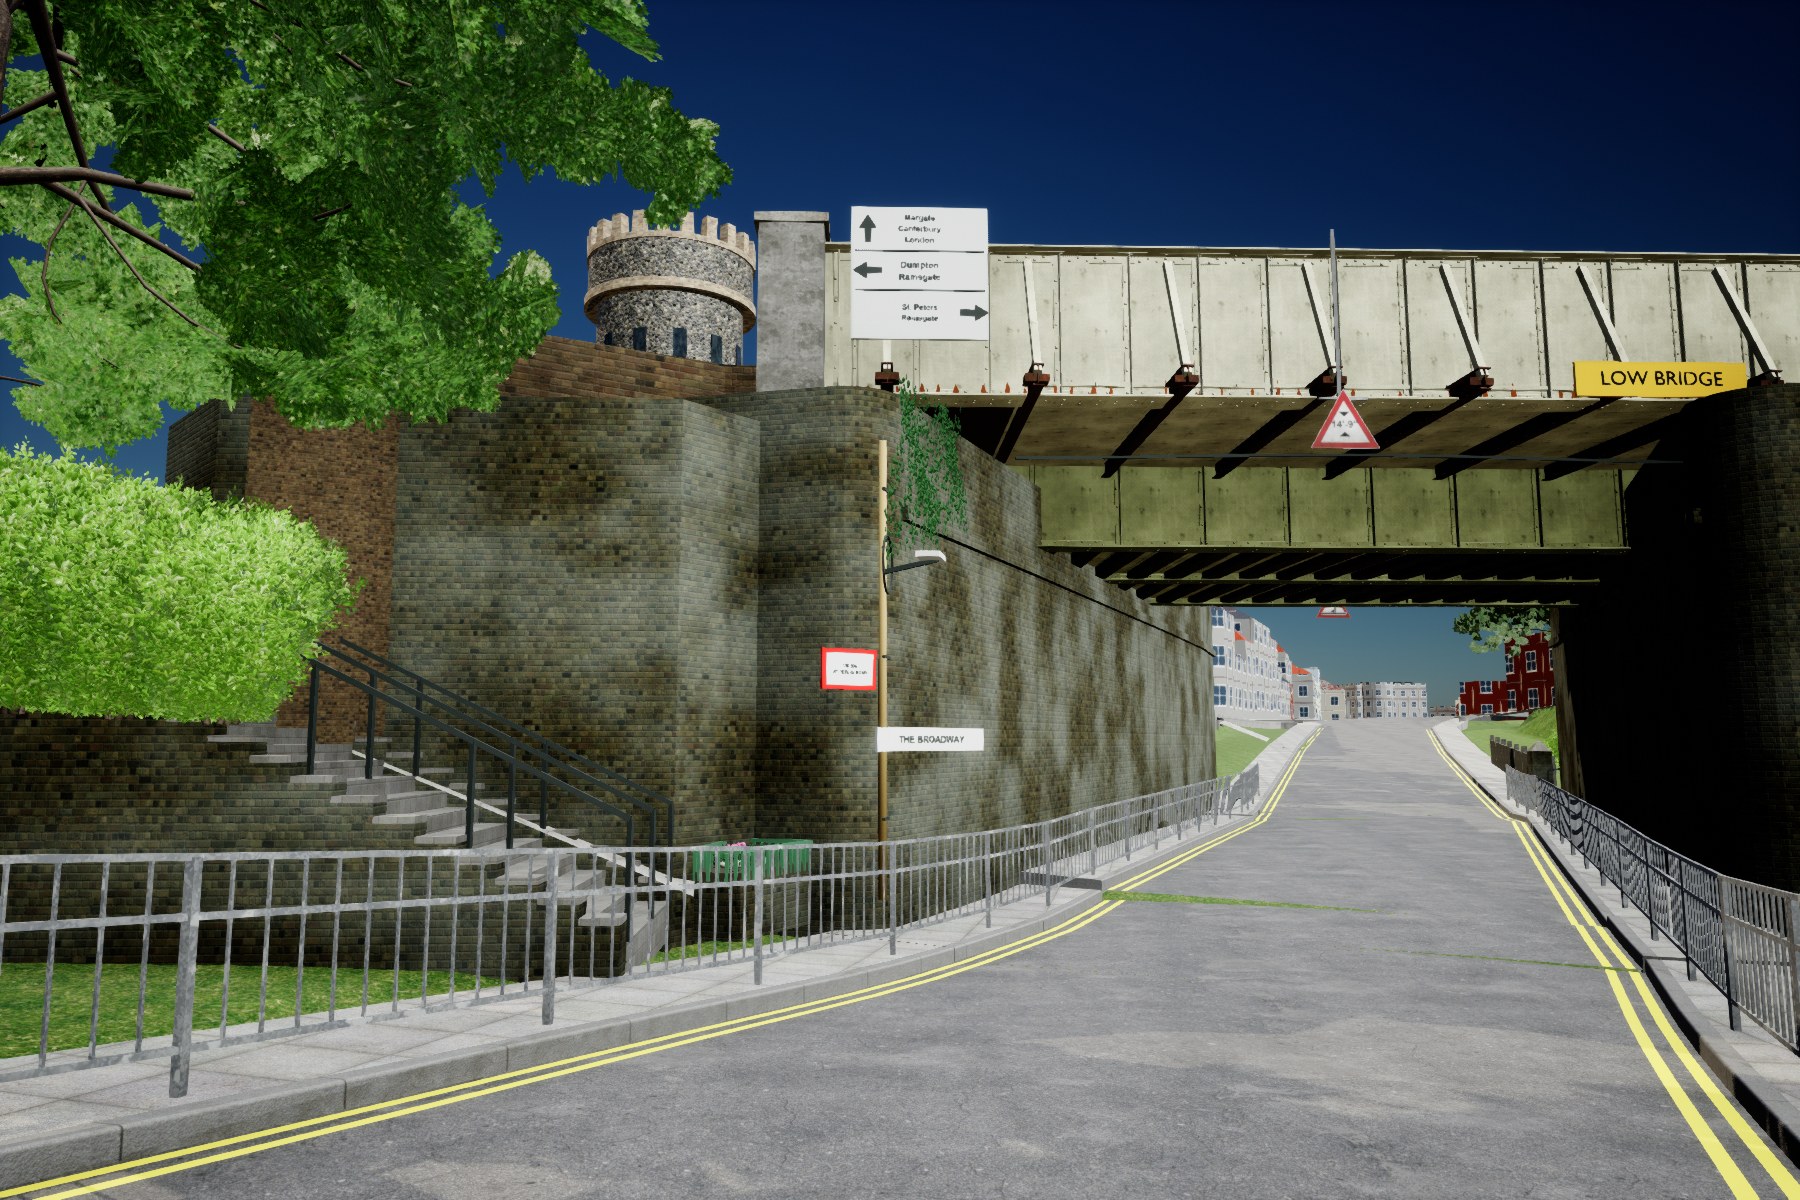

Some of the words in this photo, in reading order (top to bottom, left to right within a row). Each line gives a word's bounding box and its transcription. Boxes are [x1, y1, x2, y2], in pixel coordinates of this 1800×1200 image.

[897, 225, 942, 234] Canterbury
[904, 236, 935, 244] London
[900, 261, 939, 270] Dumpton
[1600, 370, 1649, 386] LOW
[1654, 370, 1724, 387] BRIDGE
[899, 735, 916, 744] THE
[917, 735, 965, 744] BROADWAY
